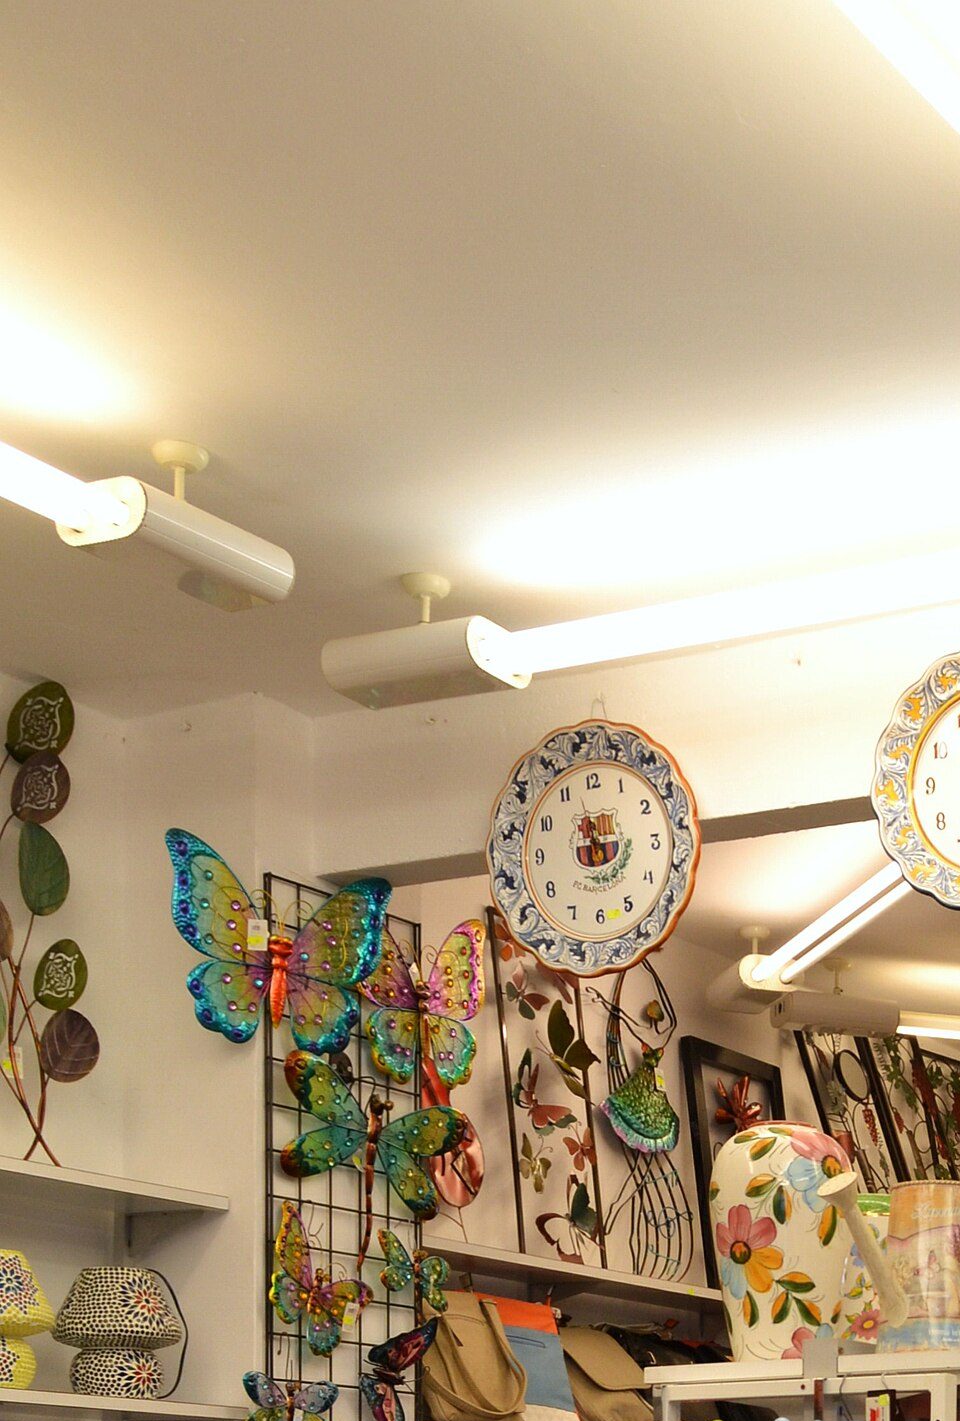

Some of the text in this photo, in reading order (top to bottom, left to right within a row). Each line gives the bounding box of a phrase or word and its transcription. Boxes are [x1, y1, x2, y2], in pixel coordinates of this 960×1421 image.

[934, 742, 947, 759] 10
[586, 773, 601, 789] 12
[618, 779, 623, 793] 1
[926, 777, 935, 794] 9
[560, 787, 570, 802] 11
[640, 800, 651, 814] 2
[541, 815, 552, 832] 10
[936, 813, 946, 829] 8
[651, 834, 660, 850] 3
[536, 849, 544, 865] 9
[582, 874, 625, 894] BARCELONA
[643, 871, 653, 884] 4
[546, 882, 556, 898] 8
[624, 896, 633, 912] 5
[568, 906, 576, 920] 7
[596, 910, 604, 924] 6
